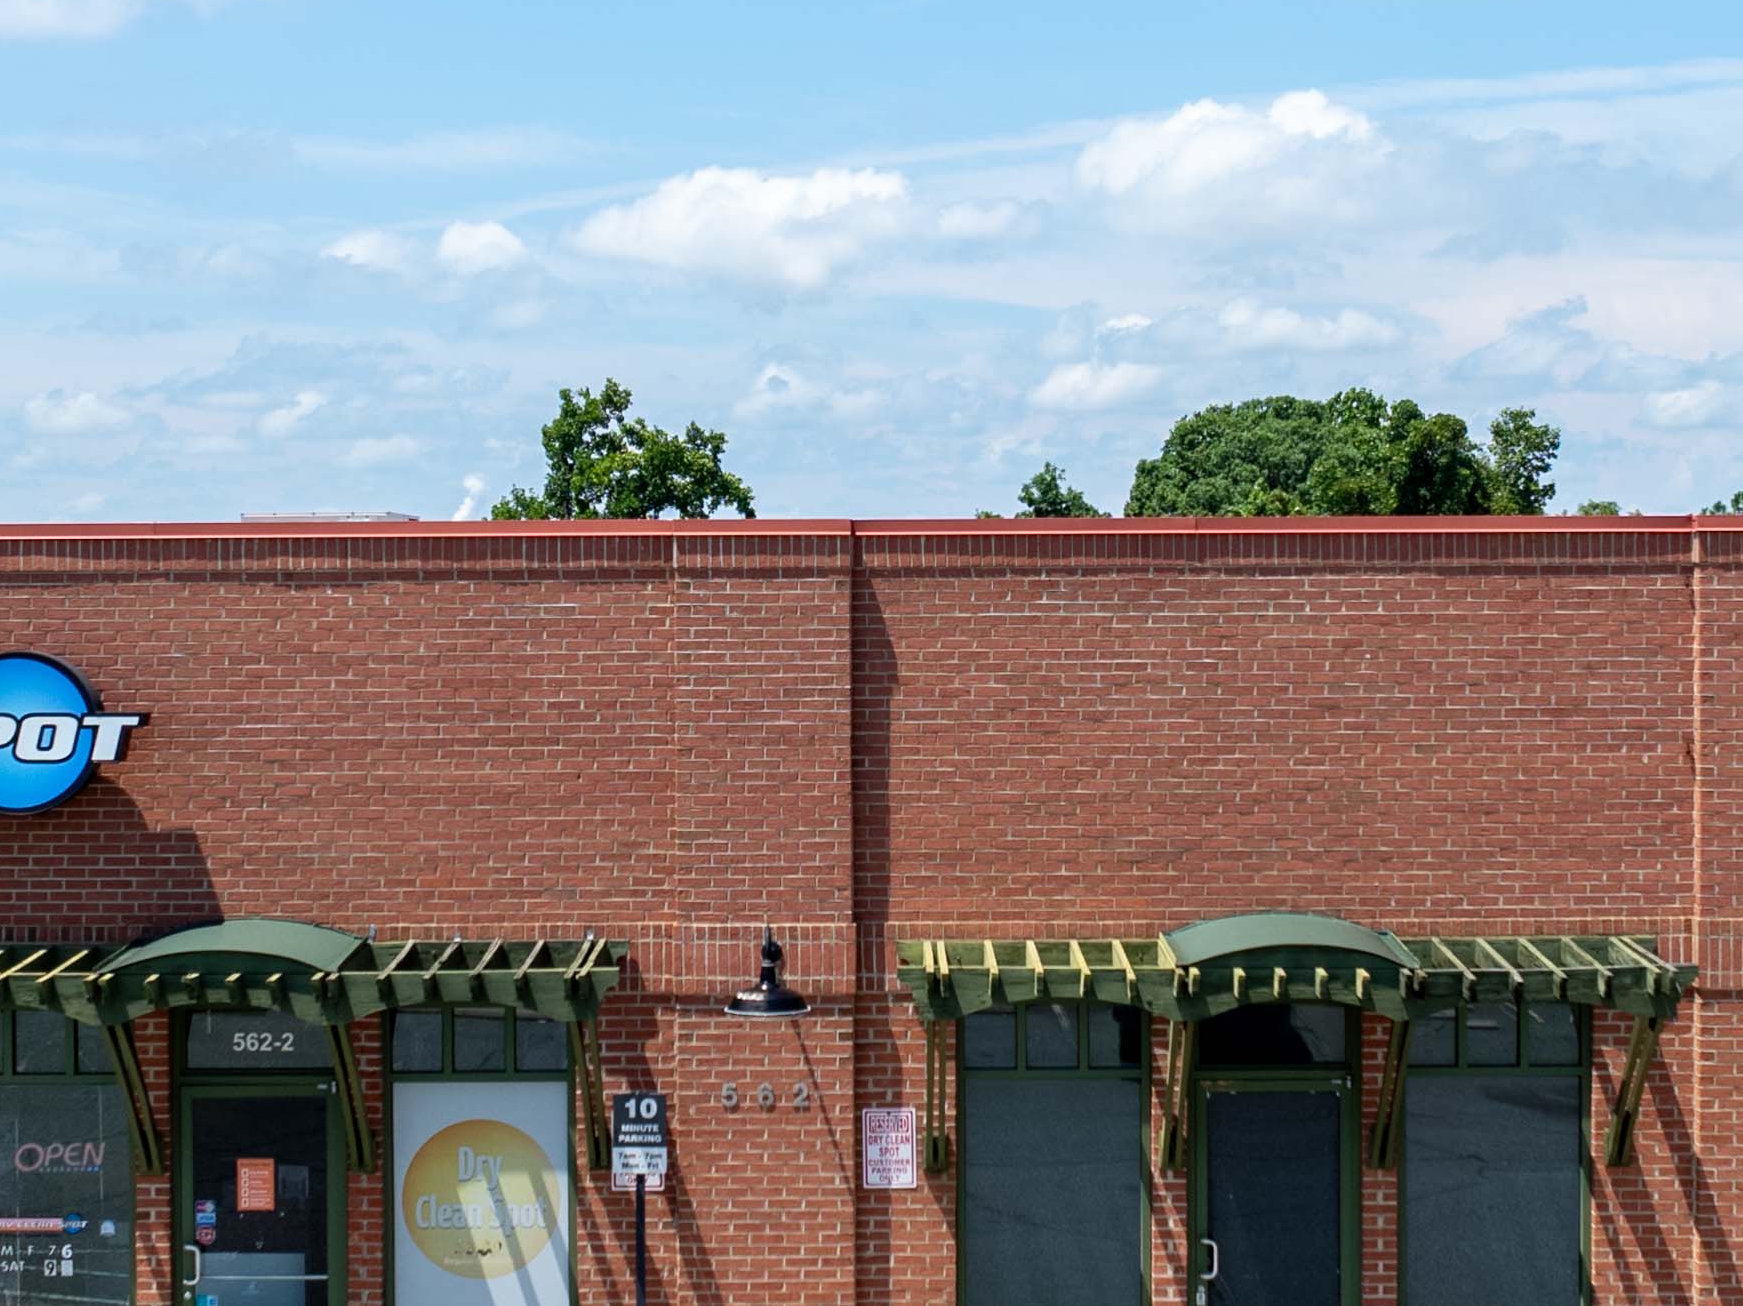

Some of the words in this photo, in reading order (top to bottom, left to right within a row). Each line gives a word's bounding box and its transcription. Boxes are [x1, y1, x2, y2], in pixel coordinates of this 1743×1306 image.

[233, 1033, 294, 1051] 562-2
[721, 1082, 809, 1107] 562
[625, 1098, 657, 1119] 10
[621, 1124, 659, 1132] MINUTE
[870, 1117, 908, 1131] RESERVED
[618, 1134, 662, 1143] PARKING
[869, 1136, 882, 1144] DRY
[885, 1136, 910, 1144] CLEAN
[14, 1142, 105, 1171] OPEN
[879, 1147, 900, 1157] SPOT
[458, 1146, 503, 1190] Dry
[416, 1195, 483, 1230] Clean
[490, 1196, 546, 1237] Spot
[1, 1245, 14, 1255] M
[28, 1245, 35, 1255] F
[49, 1245, 57, 1255] 7
[61, 1243, 73, 1258] 6
[1, 1261, 25, 1272] SAT
